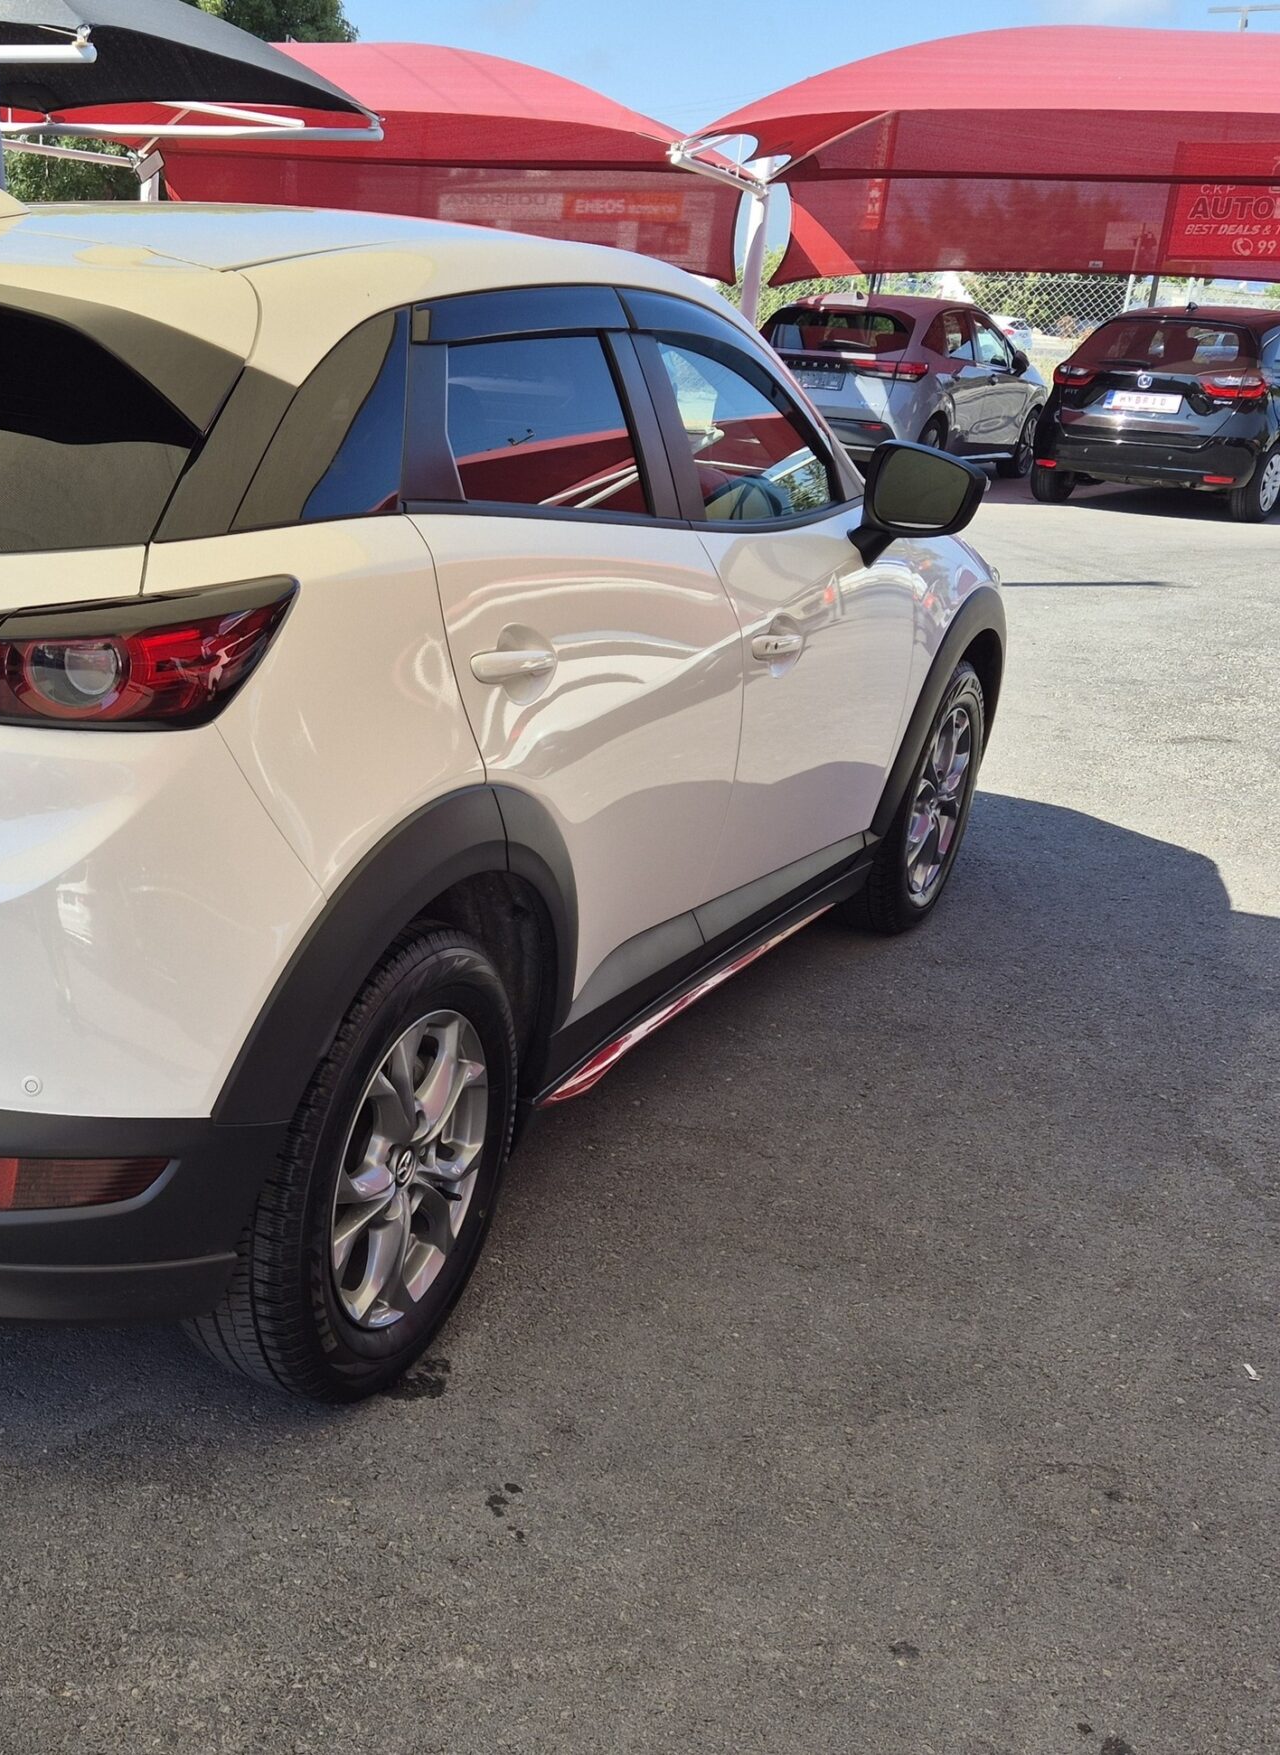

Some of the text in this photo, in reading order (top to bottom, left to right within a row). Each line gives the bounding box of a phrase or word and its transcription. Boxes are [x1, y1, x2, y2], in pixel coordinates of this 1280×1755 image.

[1187, 195, 1275, 220] AUTO
[1184, 224, 1218, 235] BEST
[1217, 224, 1261, 235] DEALS
[1261, 224, 1272, 235] &
